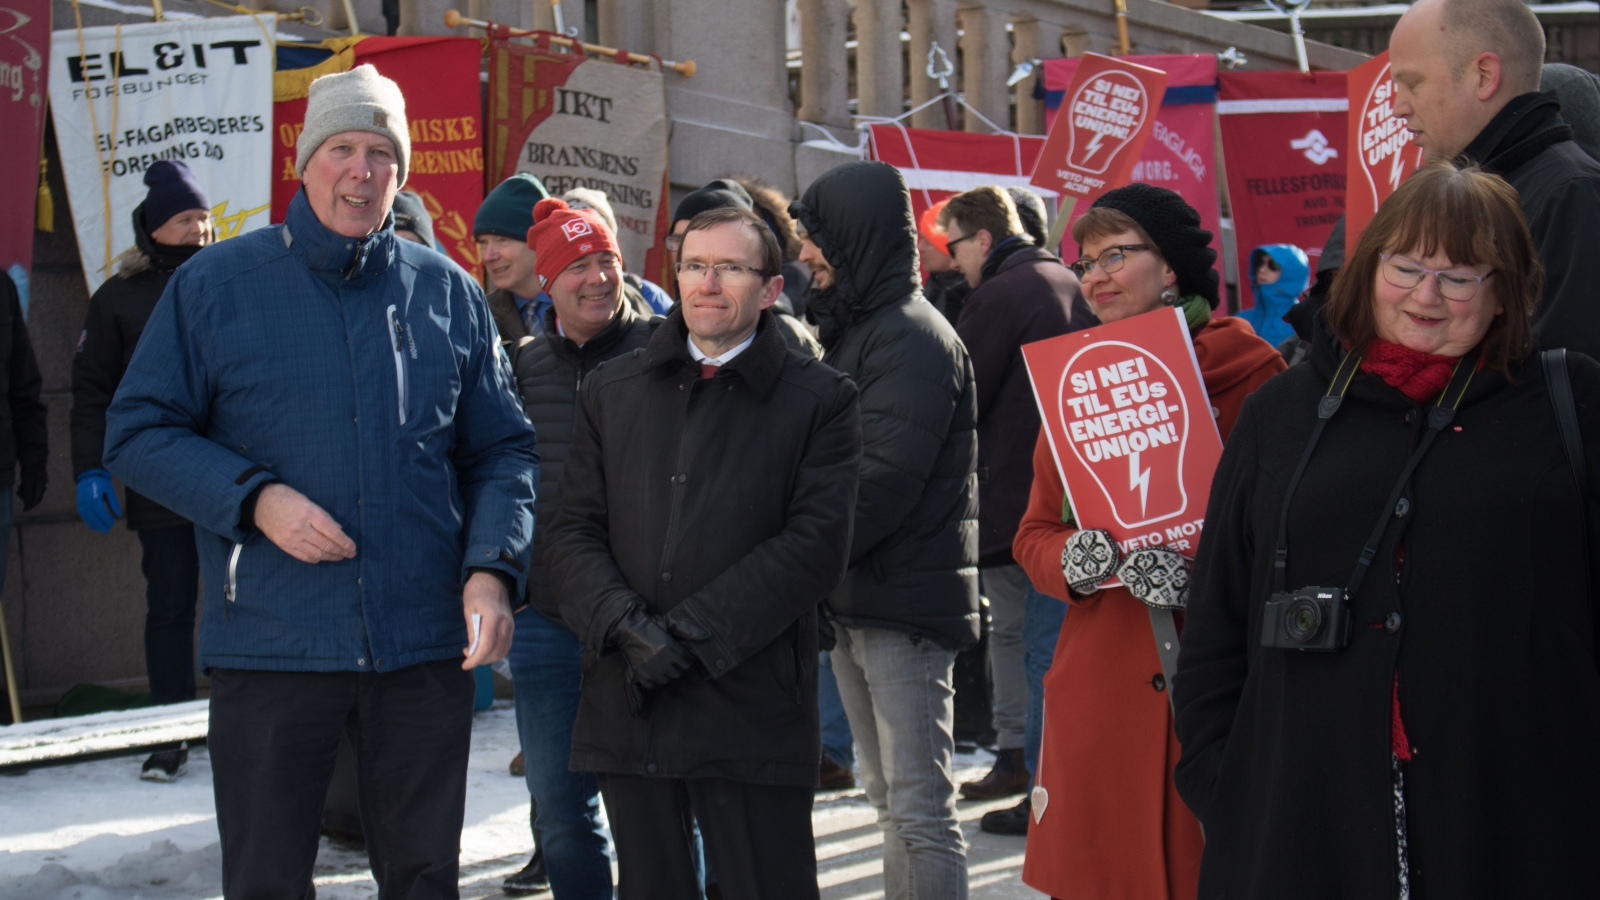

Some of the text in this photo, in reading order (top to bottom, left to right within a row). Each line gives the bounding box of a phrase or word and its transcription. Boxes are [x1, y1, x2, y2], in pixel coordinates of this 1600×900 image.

[67, 40, 262, 84] EL&IT
[72, 73, 209, 101] FORBUNDET
[1083, 89, 1107, 107] TIL
[1093, 78, 1140, 102] SI NEI
[1374, 79, 1393, 105] SI
[557, 88, 613, 124] IKT
[1074, 101, 1138, 127] ENERGI-
[1367, 100, 1394, 128] TIL
[1074, 115, 1131, 140] UNION!
[527, 142, 639, 176] BRANSJENS
[1152, 120, 1206, 183] FAGLIGE
[1056, 168, 1106, 189] VETO MOT
[1063, 181, 1091, 195] ACER
[1070, 356, 1149, 394] SI NEI
[1066, 380, 1168, 418] TIL EUs
[1069, 400, 1179, 443] ENERGI-
[1083, 422, 1180, 463] UNION!
[1116, 532, 1163, 554] VETO
